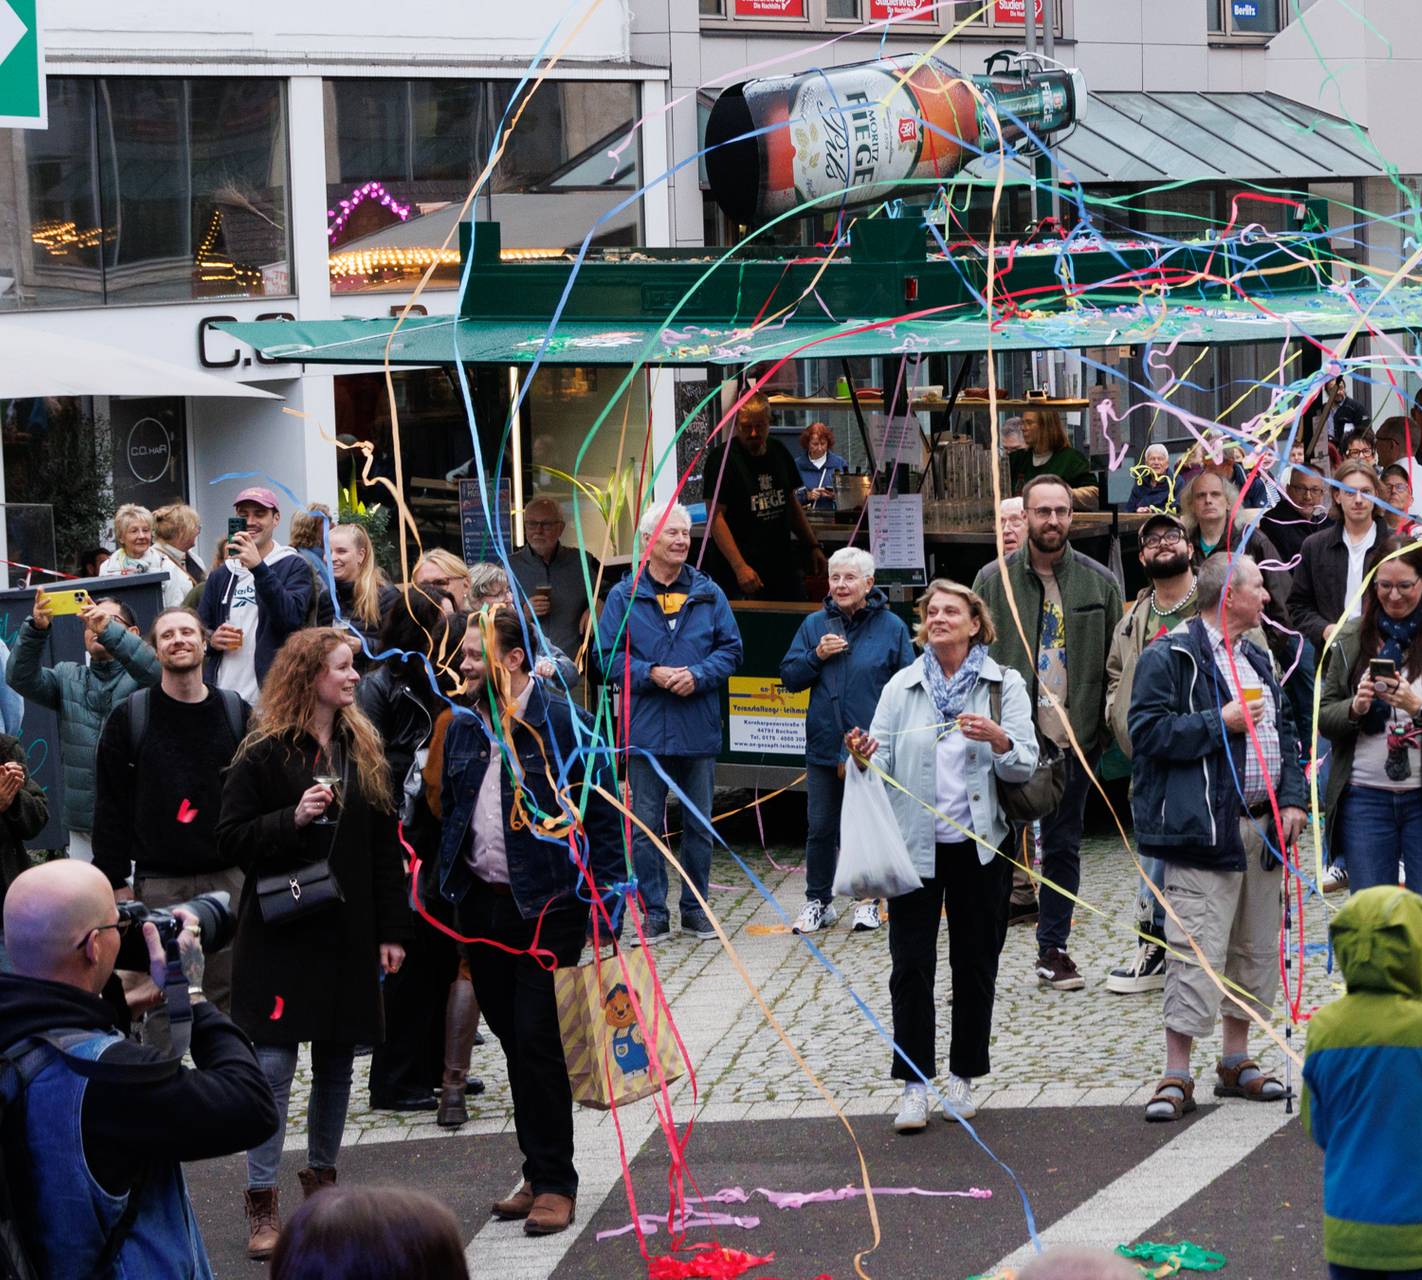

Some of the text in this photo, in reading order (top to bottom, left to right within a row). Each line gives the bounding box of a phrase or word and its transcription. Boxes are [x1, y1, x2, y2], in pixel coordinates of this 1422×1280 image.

[1234, 4, 1256, 15] Berlitz
[1040, 81, 1054, 124] FIEGE
[846, 90, 875, 186] FIEGE
[867, 109, 880, 163] MORITZ
